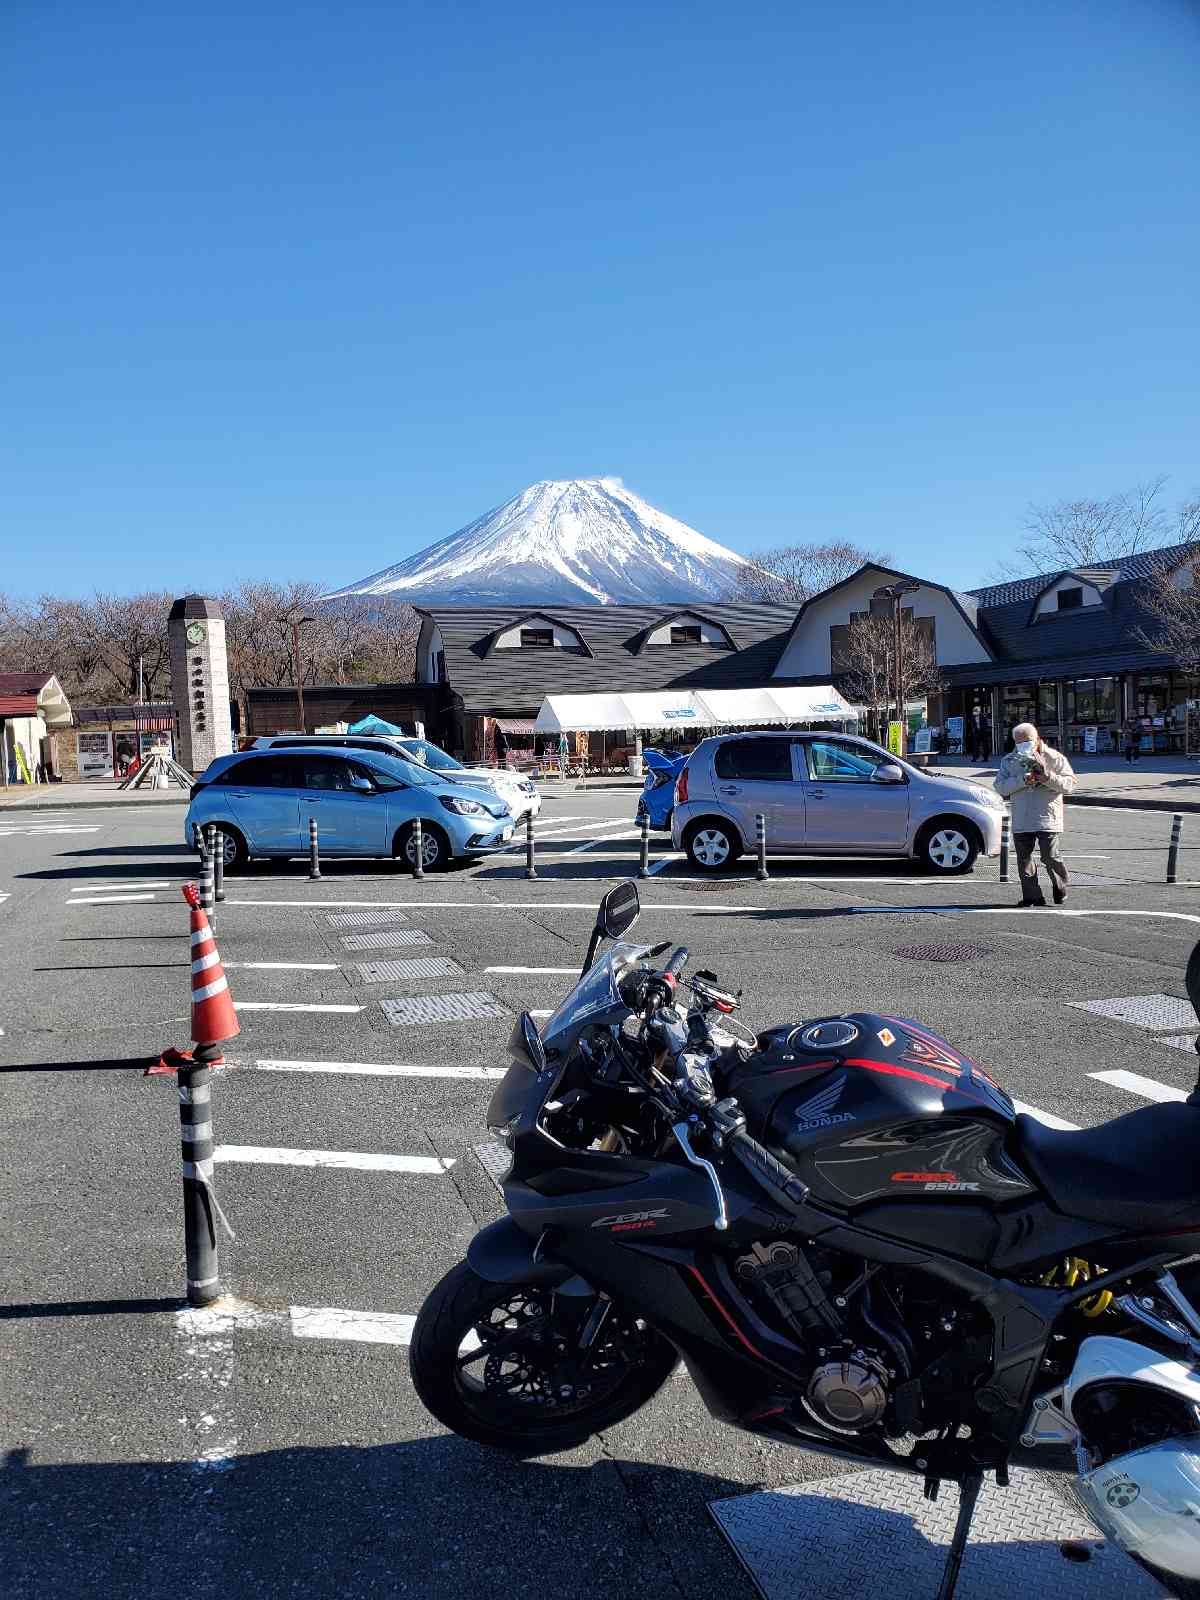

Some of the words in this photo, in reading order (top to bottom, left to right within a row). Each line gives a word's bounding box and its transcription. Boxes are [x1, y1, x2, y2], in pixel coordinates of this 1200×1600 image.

[798, 1112, 857, 1132] HONDA
[890, 1171, 957, 1184] CBR
[924, 1182, 982, 1192] 650R
